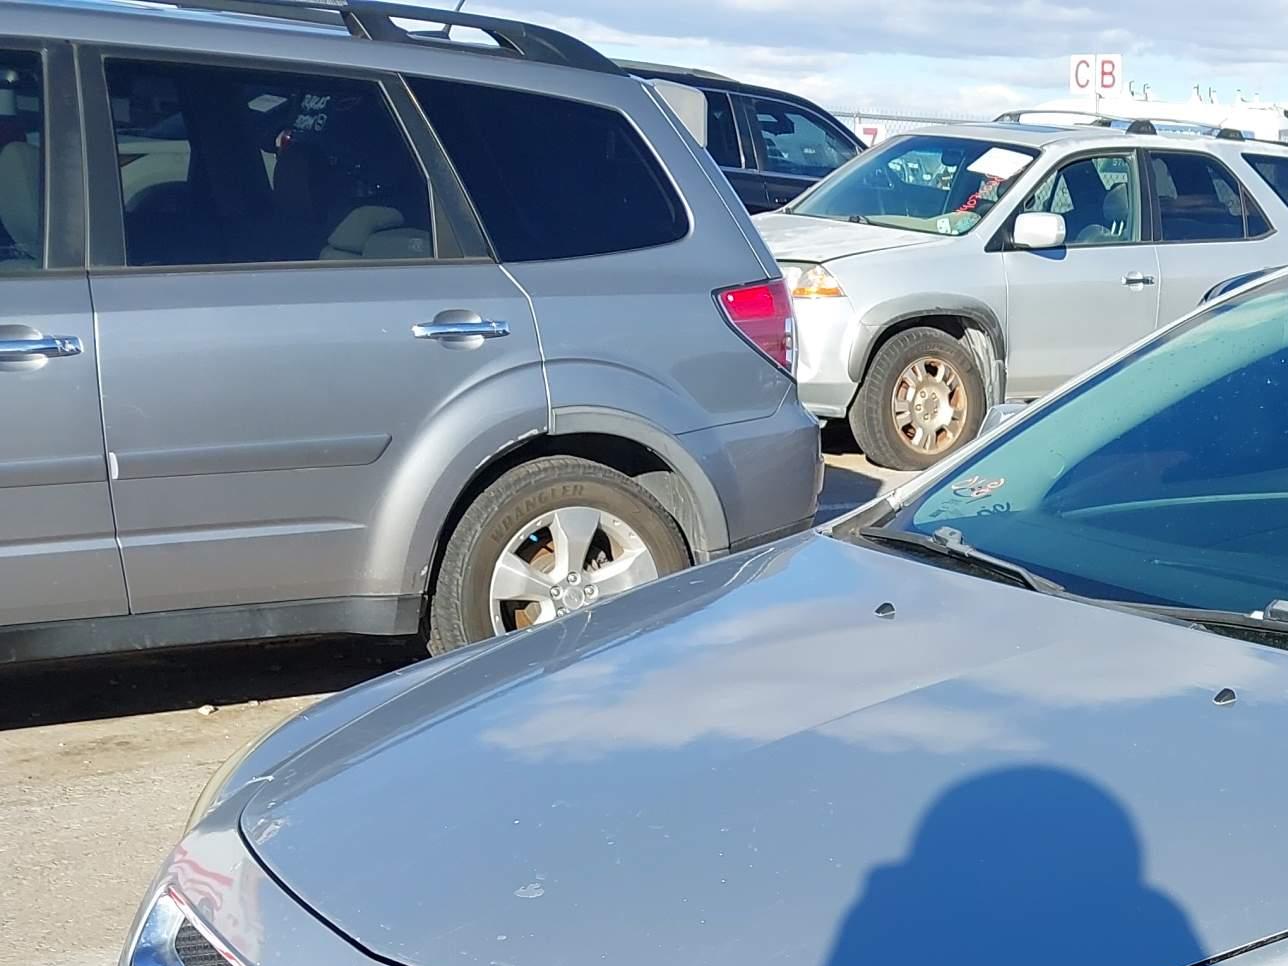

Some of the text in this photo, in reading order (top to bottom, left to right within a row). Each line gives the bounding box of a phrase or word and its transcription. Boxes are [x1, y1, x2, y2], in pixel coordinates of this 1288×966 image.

[1074, 60, 1116, 88] C B
[863, 127, 878, 147] 7
